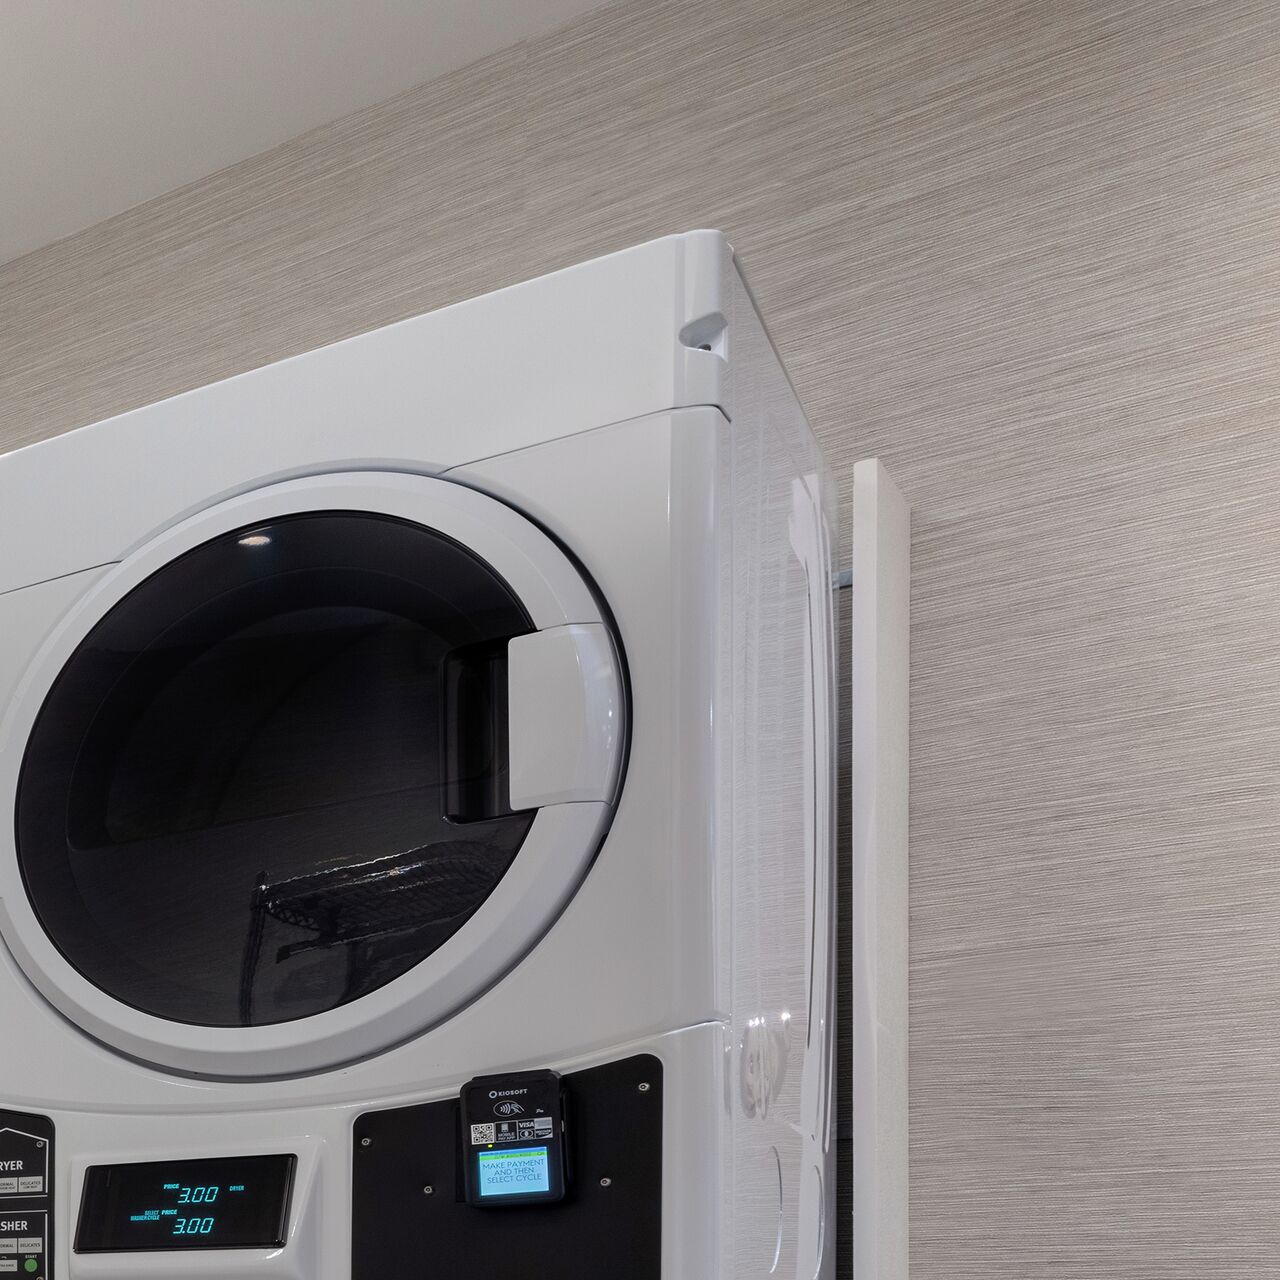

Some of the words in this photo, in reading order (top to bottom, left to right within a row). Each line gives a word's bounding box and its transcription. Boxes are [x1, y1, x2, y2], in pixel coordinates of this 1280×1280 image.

[498, 1088, 528, 1096] KIOSOFT
[482, 1161, 505, 1170] MAKE
[507, 1159, 544, 1168] PAYMENT
[494, 1168, 512, 1176] AND
[488, 1176, 514, 1184] SELECT
[516, 1174, 542, 1182] CYCLE
[178, 1187, 218, 1203] 3.00
[173, 1218, 214, 1234] 3.00
